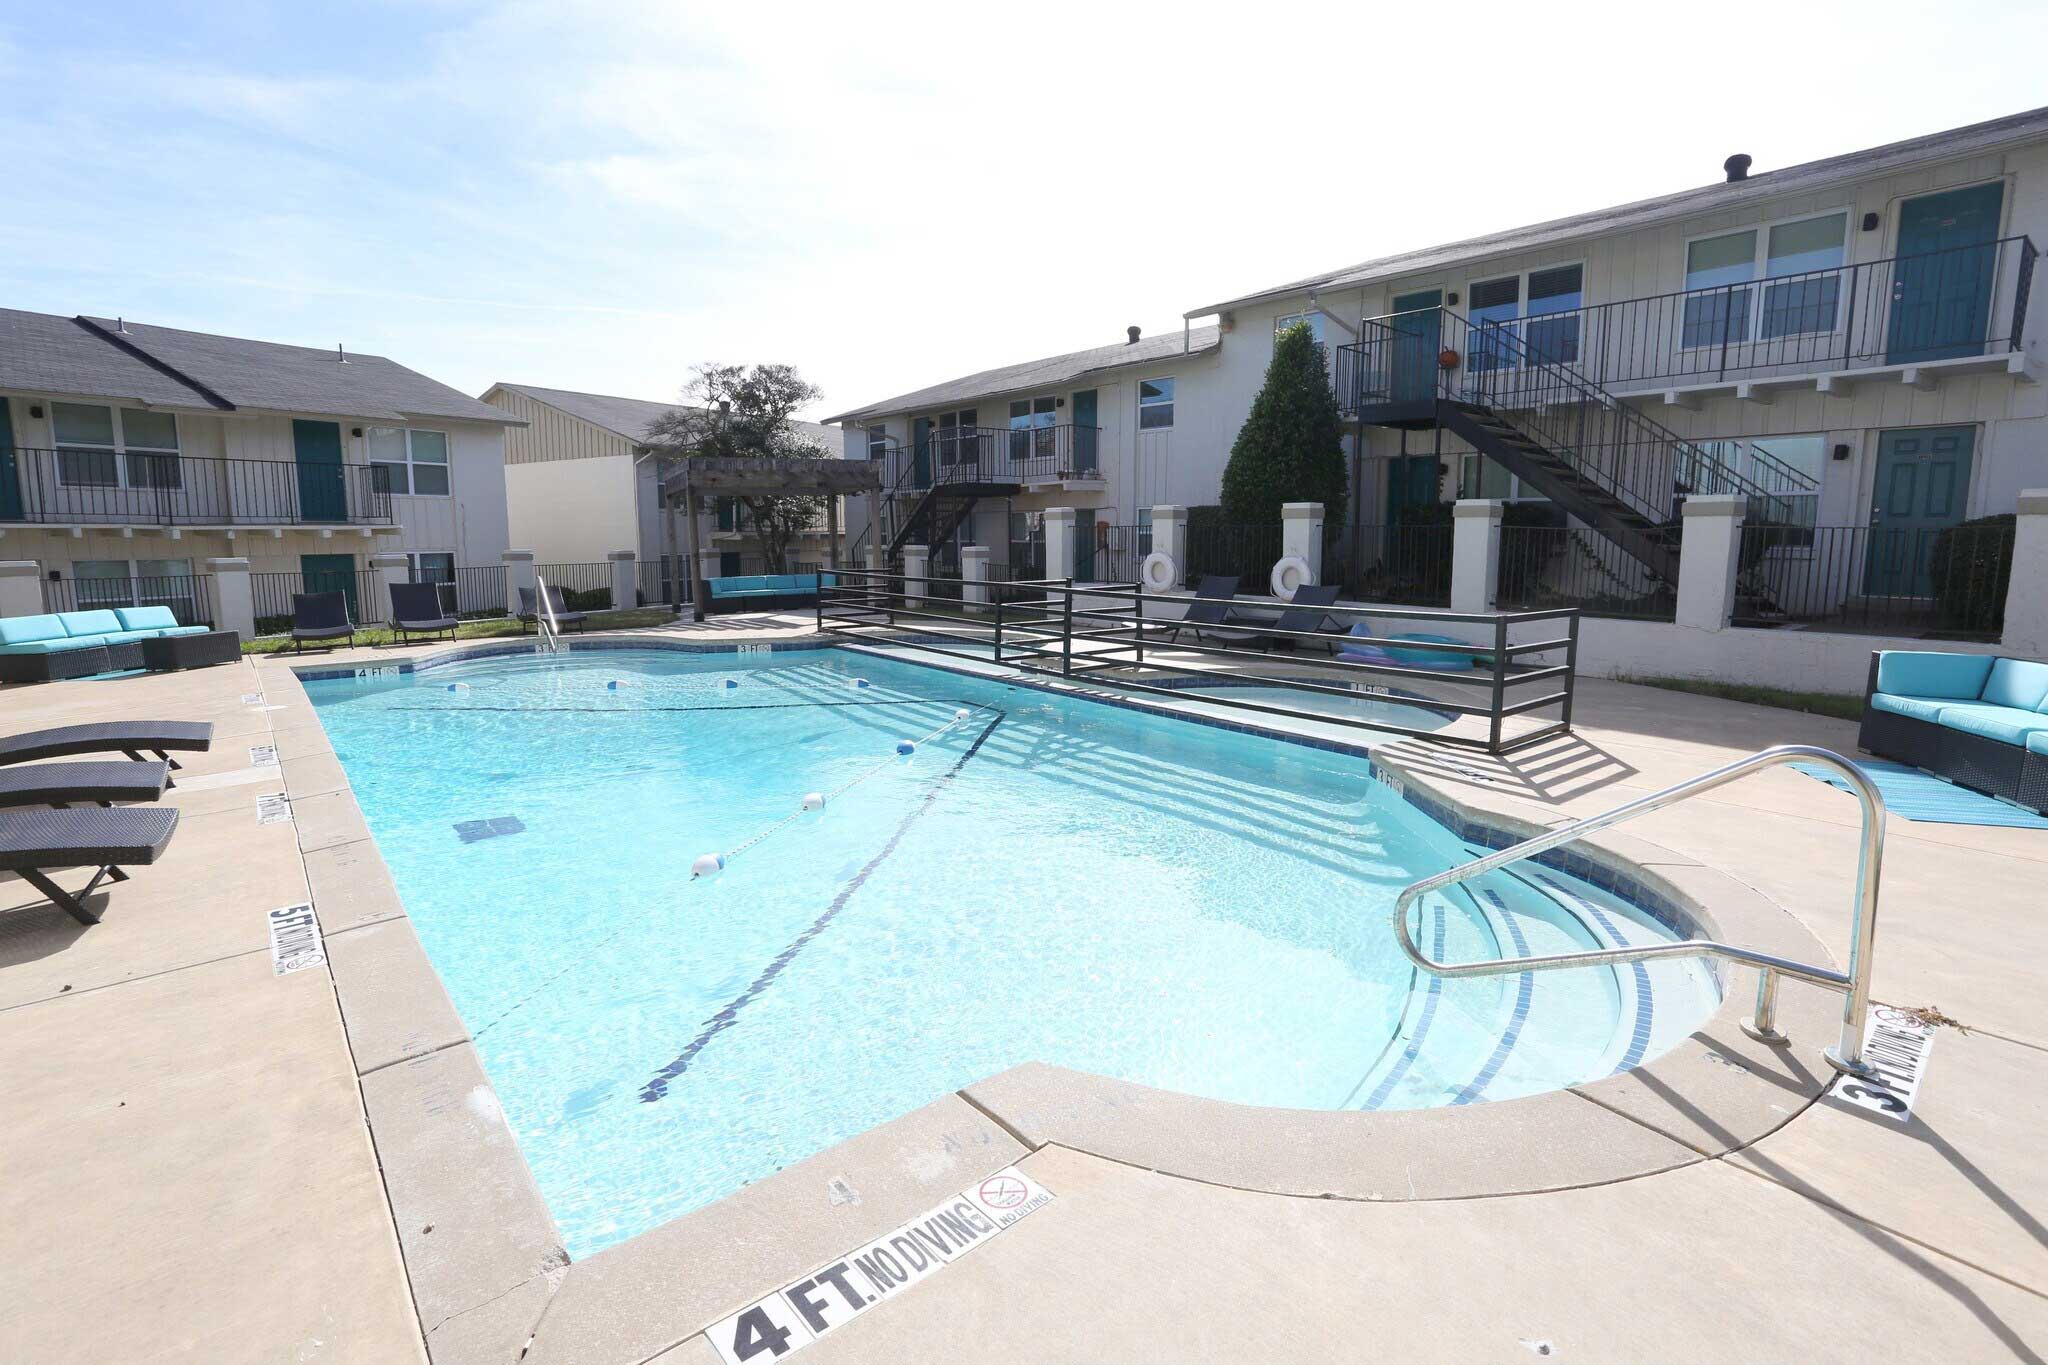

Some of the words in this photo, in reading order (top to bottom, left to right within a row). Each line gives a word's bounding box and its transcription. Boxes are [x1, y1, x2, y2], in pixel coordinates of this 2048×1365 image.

[358, 669, 367, 677] 4
[372, 667, 382, 677] FT
[270, 905, 310, 918] 5
[1868, 1024, 1925, 1063] DIVING
[1842, 1084, 1908, 1113] 3
[999, 1213, 1017, 1225] NO
[1014, 1193, 1048, 1217] DIVING
[733, 1305, 792, 1363] 4
[854, 1247, 908, 1294] NO
[889, 1202, 994, 1273] DIVING
